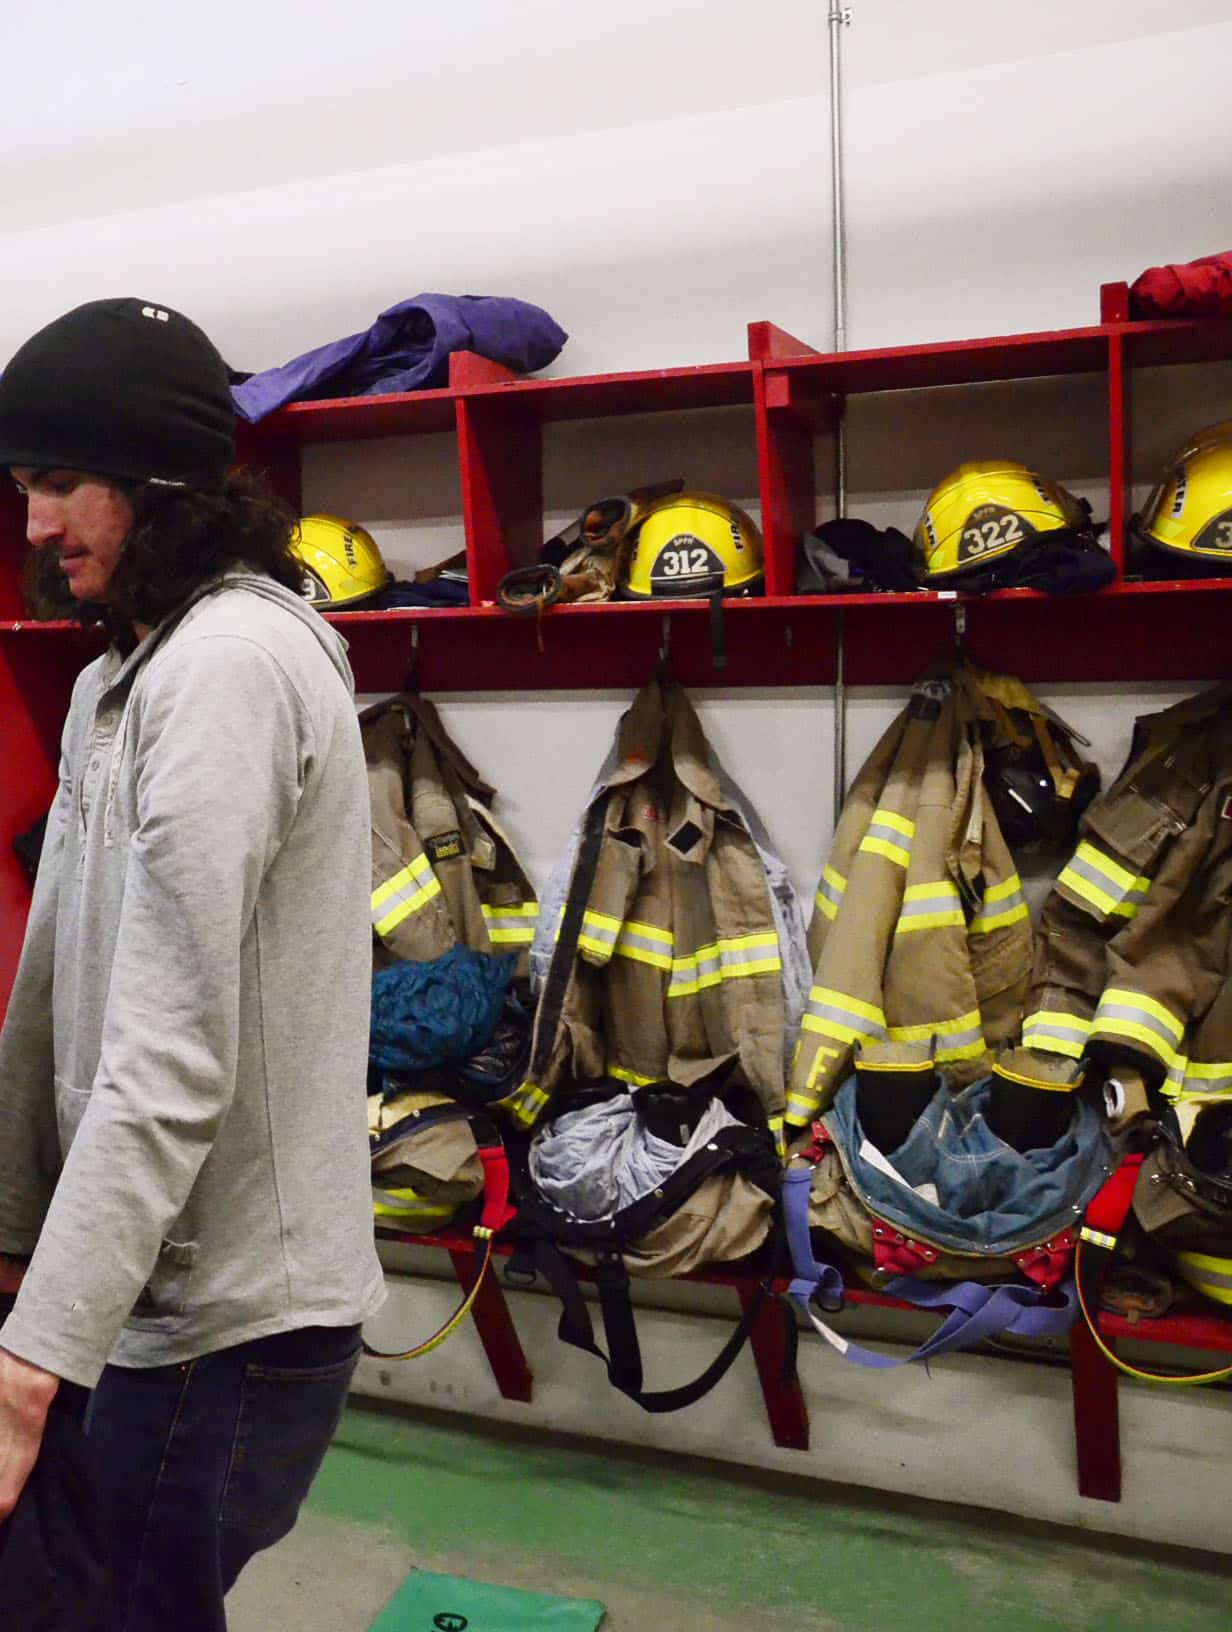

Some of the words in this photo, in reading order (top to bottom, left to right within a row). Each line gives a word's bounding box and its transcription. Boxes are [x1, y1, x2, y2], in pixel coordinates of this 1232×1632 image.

[343, 534, 357, 567] FIRE
[963, 514, 1024, 554] 322
[662, 548, 709, 576] 312
